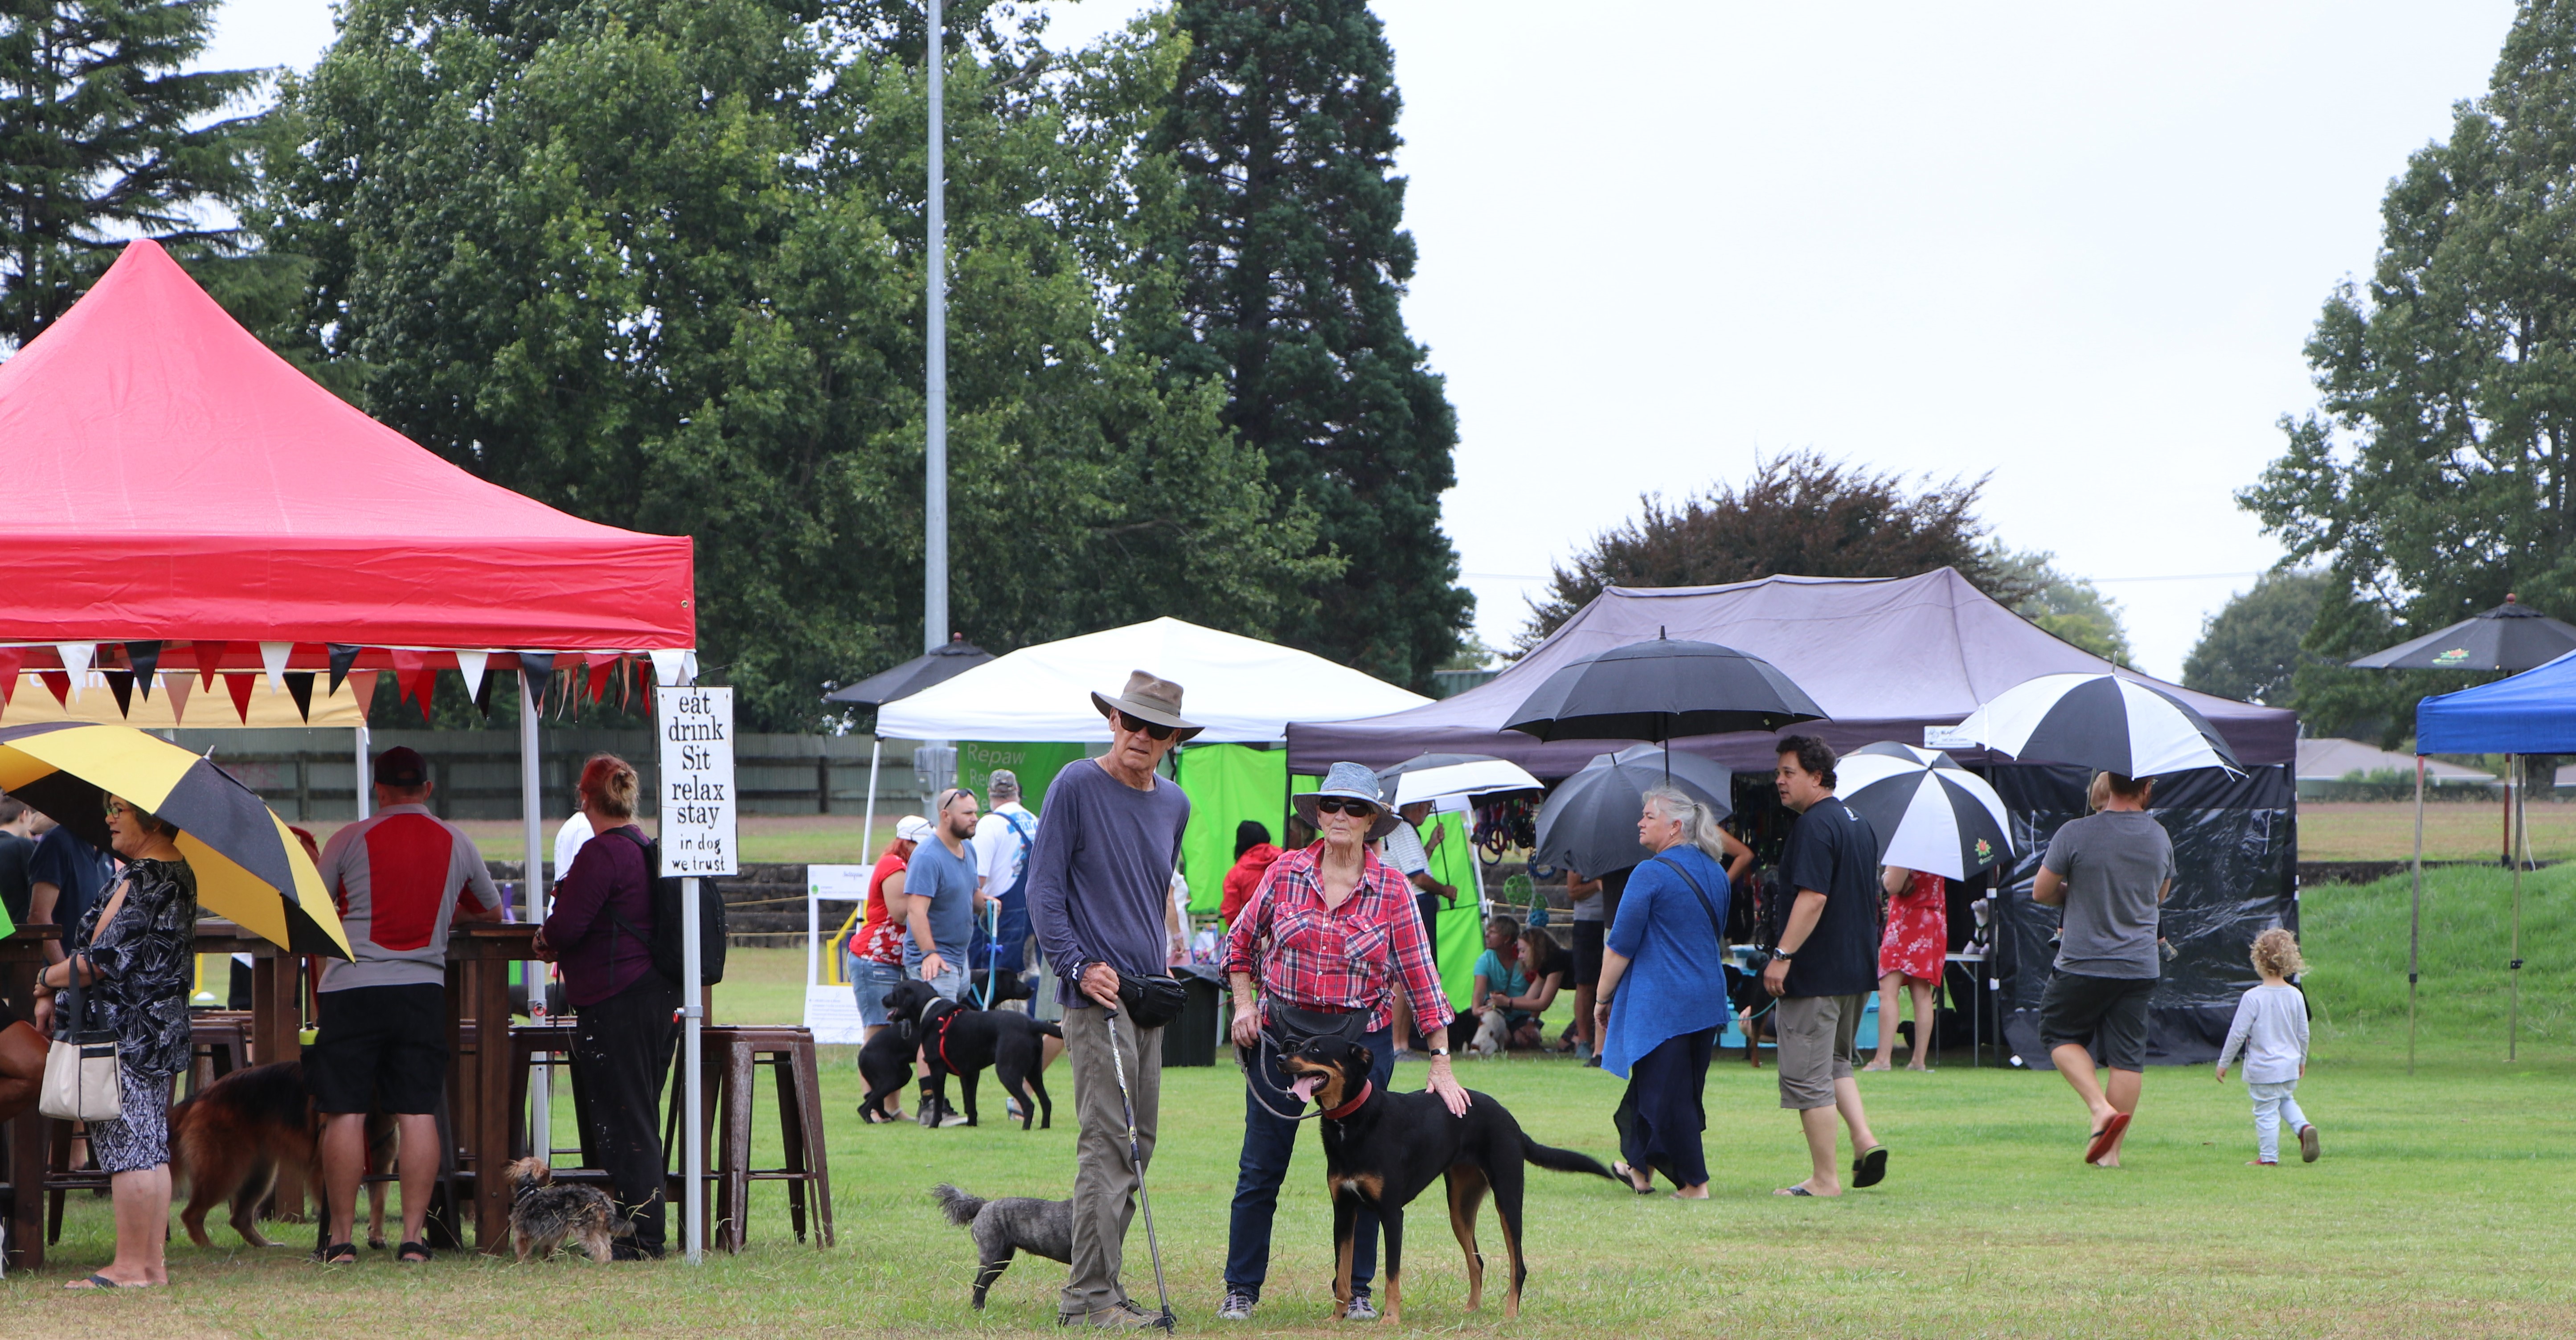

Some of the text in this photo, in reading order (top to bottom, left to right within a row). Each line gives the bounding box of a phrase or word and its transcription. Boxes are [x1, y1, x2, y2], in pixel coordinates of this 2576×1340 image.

[679, 691, 711, 714] eat
[668, 715, 724, 742] drink
[682, 745, 711, 770] Sit
[968, 743, 1025, 767] Repaw
[672, 775, 725, 801] relax
[677, 801, 720, 829] stay
[680, 833, 721, 855] in dog
[672, 855, 725, 872] we trust
[1113, 1048, 1126, 1089] FIZAN
